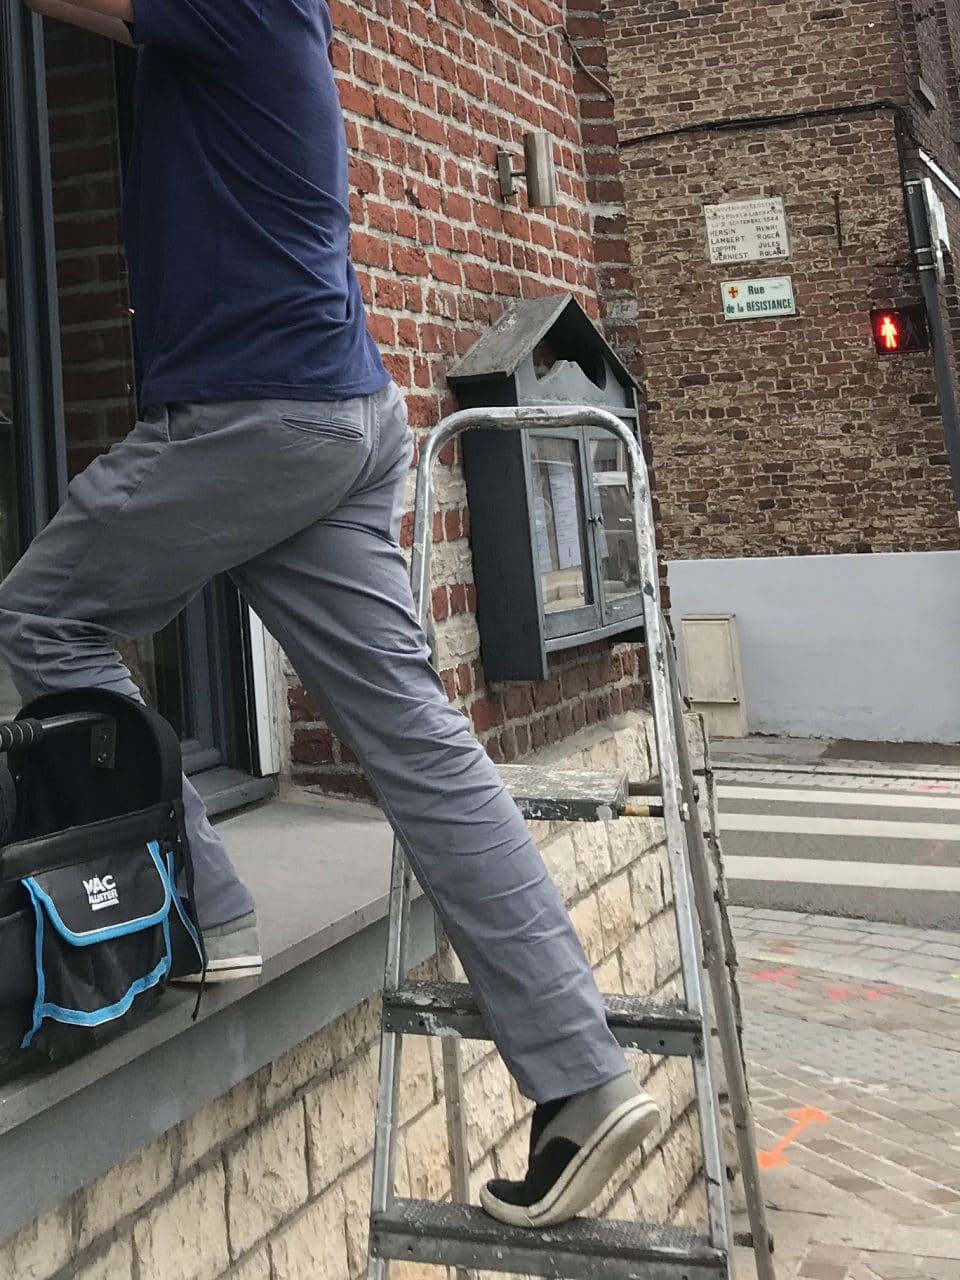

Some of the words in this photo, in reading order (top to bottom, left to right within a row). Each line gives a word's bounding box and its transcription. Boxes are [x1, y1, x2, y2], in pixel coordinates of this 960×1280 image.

[711, 236, 746, 245] LAMBERT
[748, 285, 765, 295] Rue
[727, 303, 735, 313] de
[737, 302, 744, 312] la
